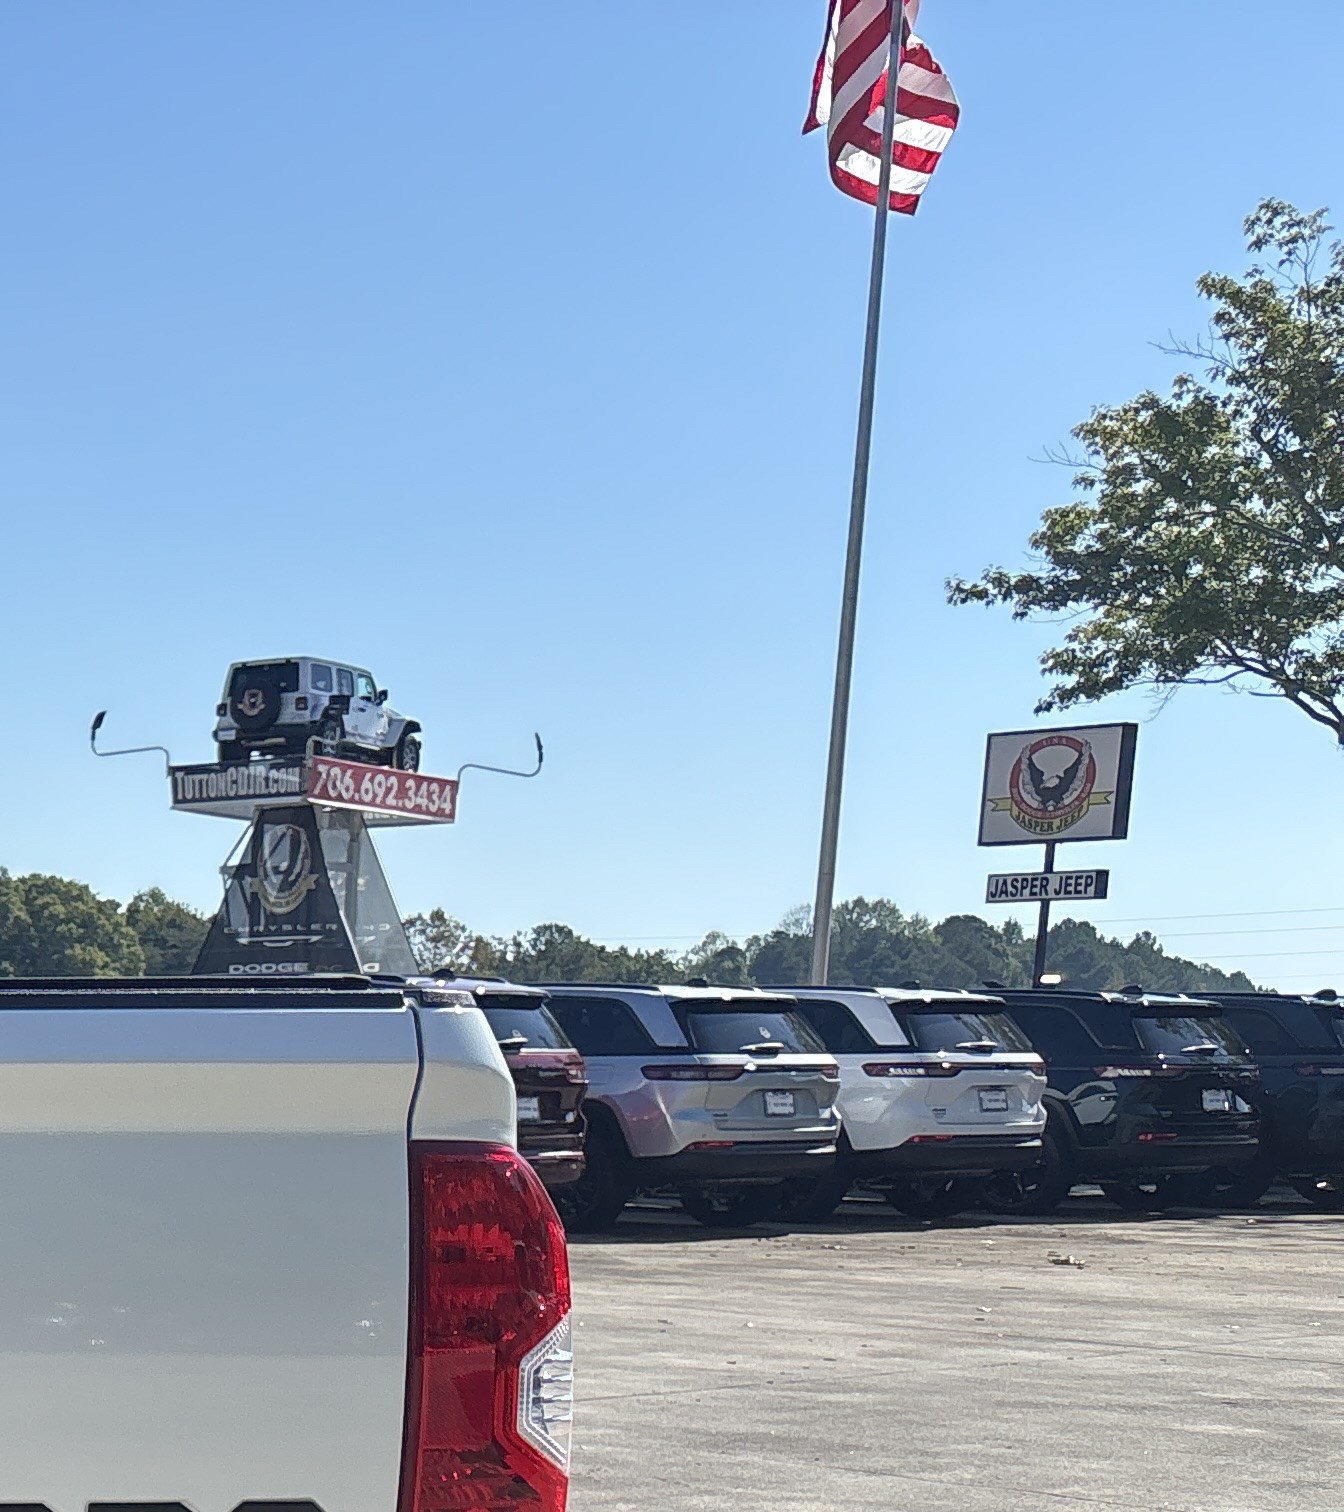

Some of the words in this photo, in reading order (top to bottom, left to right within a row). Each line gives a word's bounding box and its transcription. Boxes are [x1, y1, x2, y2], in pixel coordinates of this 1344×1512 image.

[313, 764, 452, 814] 706.692.3434
[1015, 811, 1053, 832] JASPER
[1056, 805, 1084, 830] JEEP
[990, 876, 1050, 898] JASPER
[1054, 874, 1094, 896] JEEP
[228, 962, 309, 975] DODGE
